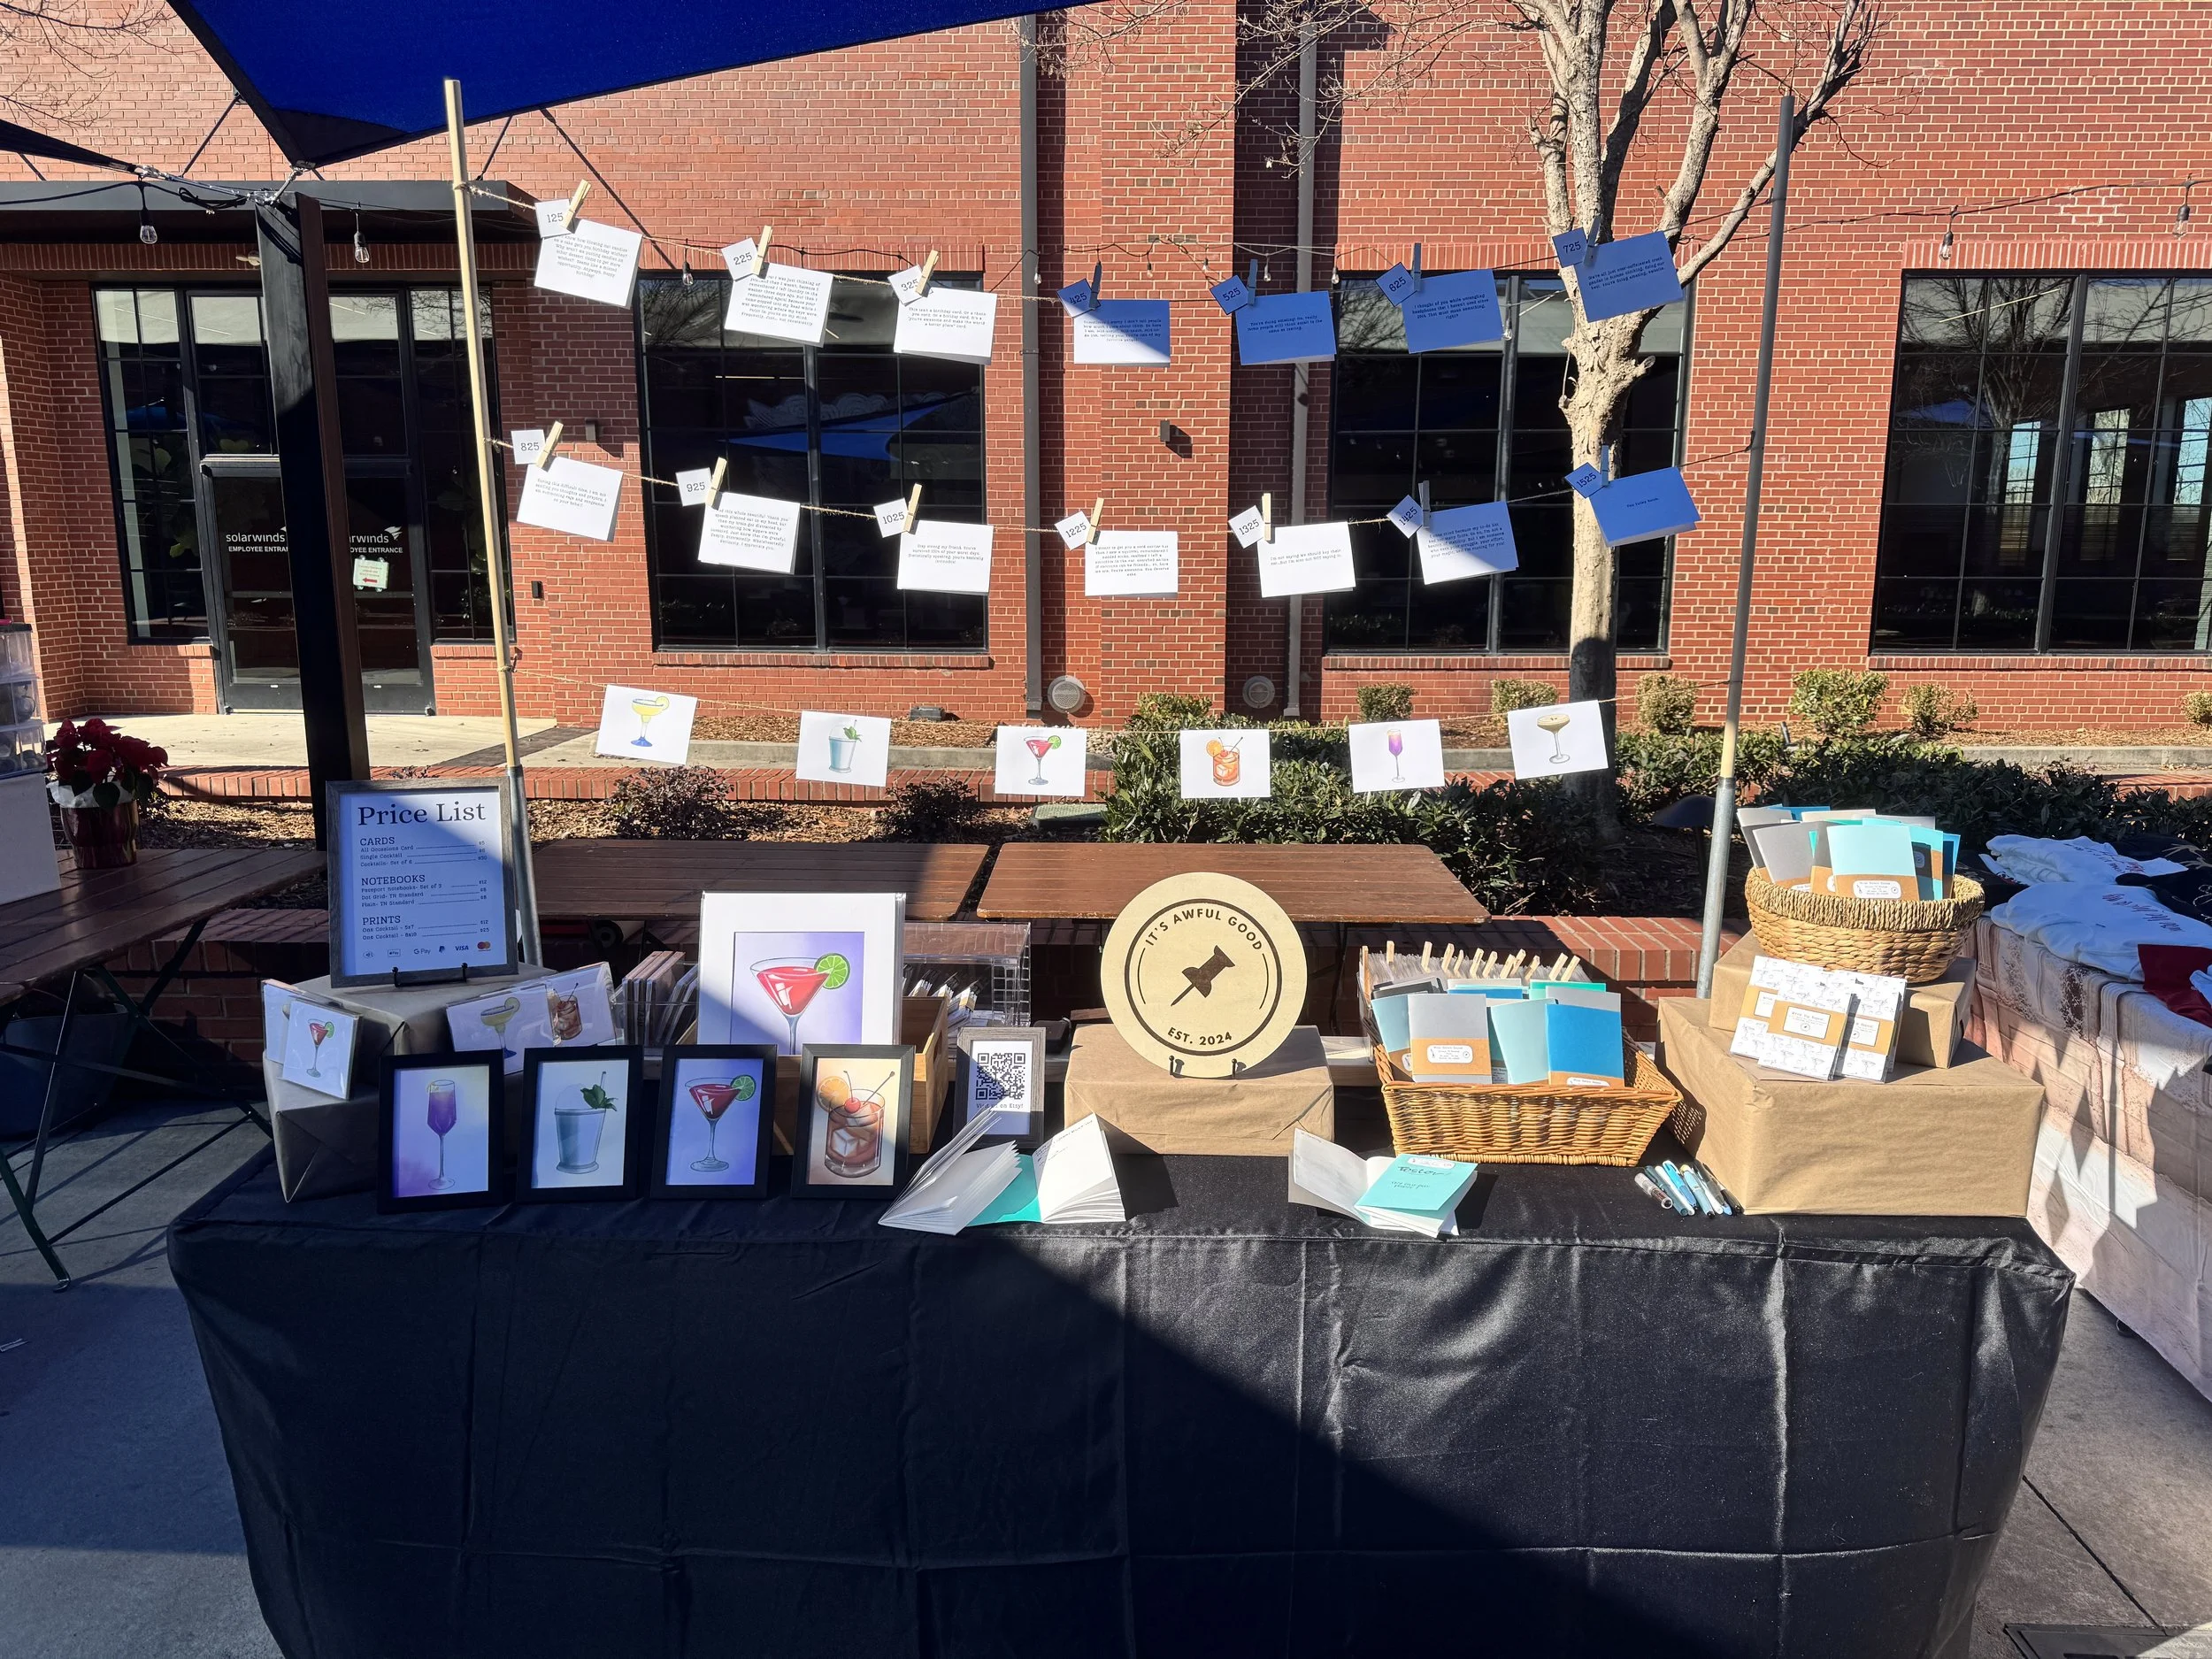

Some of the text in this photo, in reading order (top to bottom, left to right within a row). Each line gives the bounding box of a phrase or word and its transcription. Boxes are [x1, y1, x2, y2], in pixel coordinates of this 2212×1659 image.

[547, 212, 563, 223] 125
[1563, 241, 1581, 253] 725
[733, 252, 752, 265] 225
[1389, 276, 1406, 292] 625
[1070, 293, 1087, 303] 425
[1223, 288, 1240, 301] 525
[520, 442, 540, 451] 825
[1577, 472, 1596, 488] 1525
[687, 482, 705, 492] 925
[883, 511, 904, 524] 1025
[1399, 507, 1417, 526] 1425
[1066, 523, 1087, 537] 1225
[1239, 519, 1259, 535] 1325
[227, 533, 285, 541] solarwinds
[349, 534, 389, 543] rwinds
[358, 802, 487, 826] Price List
[359, 837, 395, 846] CARDS
[361, 874, 425, 886] NOTEBOOKS
[363, 916, 401, 926] PRINTS
[1145, 909, 1262, 950] IT'S AWFUL GOOD
[1168, 1026, 1232, 1046] EST. 2024
